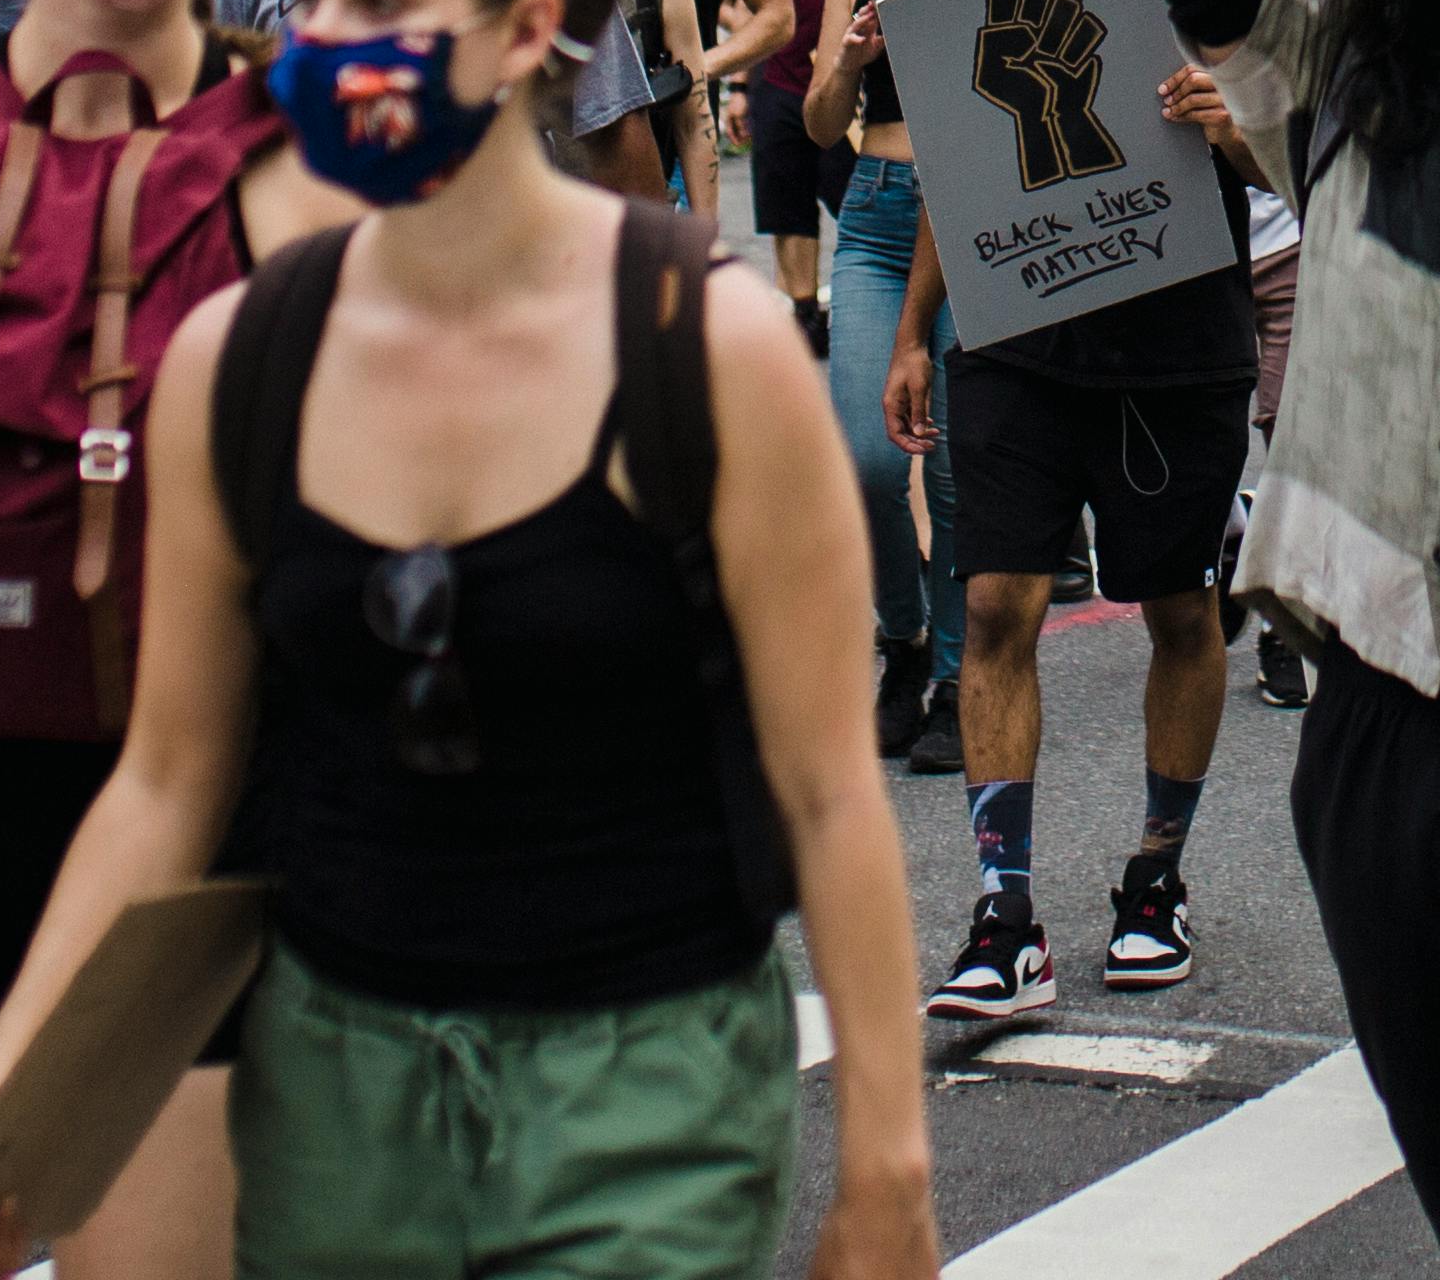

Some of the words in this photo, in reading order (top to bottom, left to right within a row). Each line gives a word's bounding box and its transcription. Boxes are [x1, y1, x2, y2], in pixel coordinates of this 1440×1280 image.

[973, 212, 1073, 263] BLACK
[1085, 180, 1173, 227] LIVES
[1019, 223, 1170, 290] MATTER
